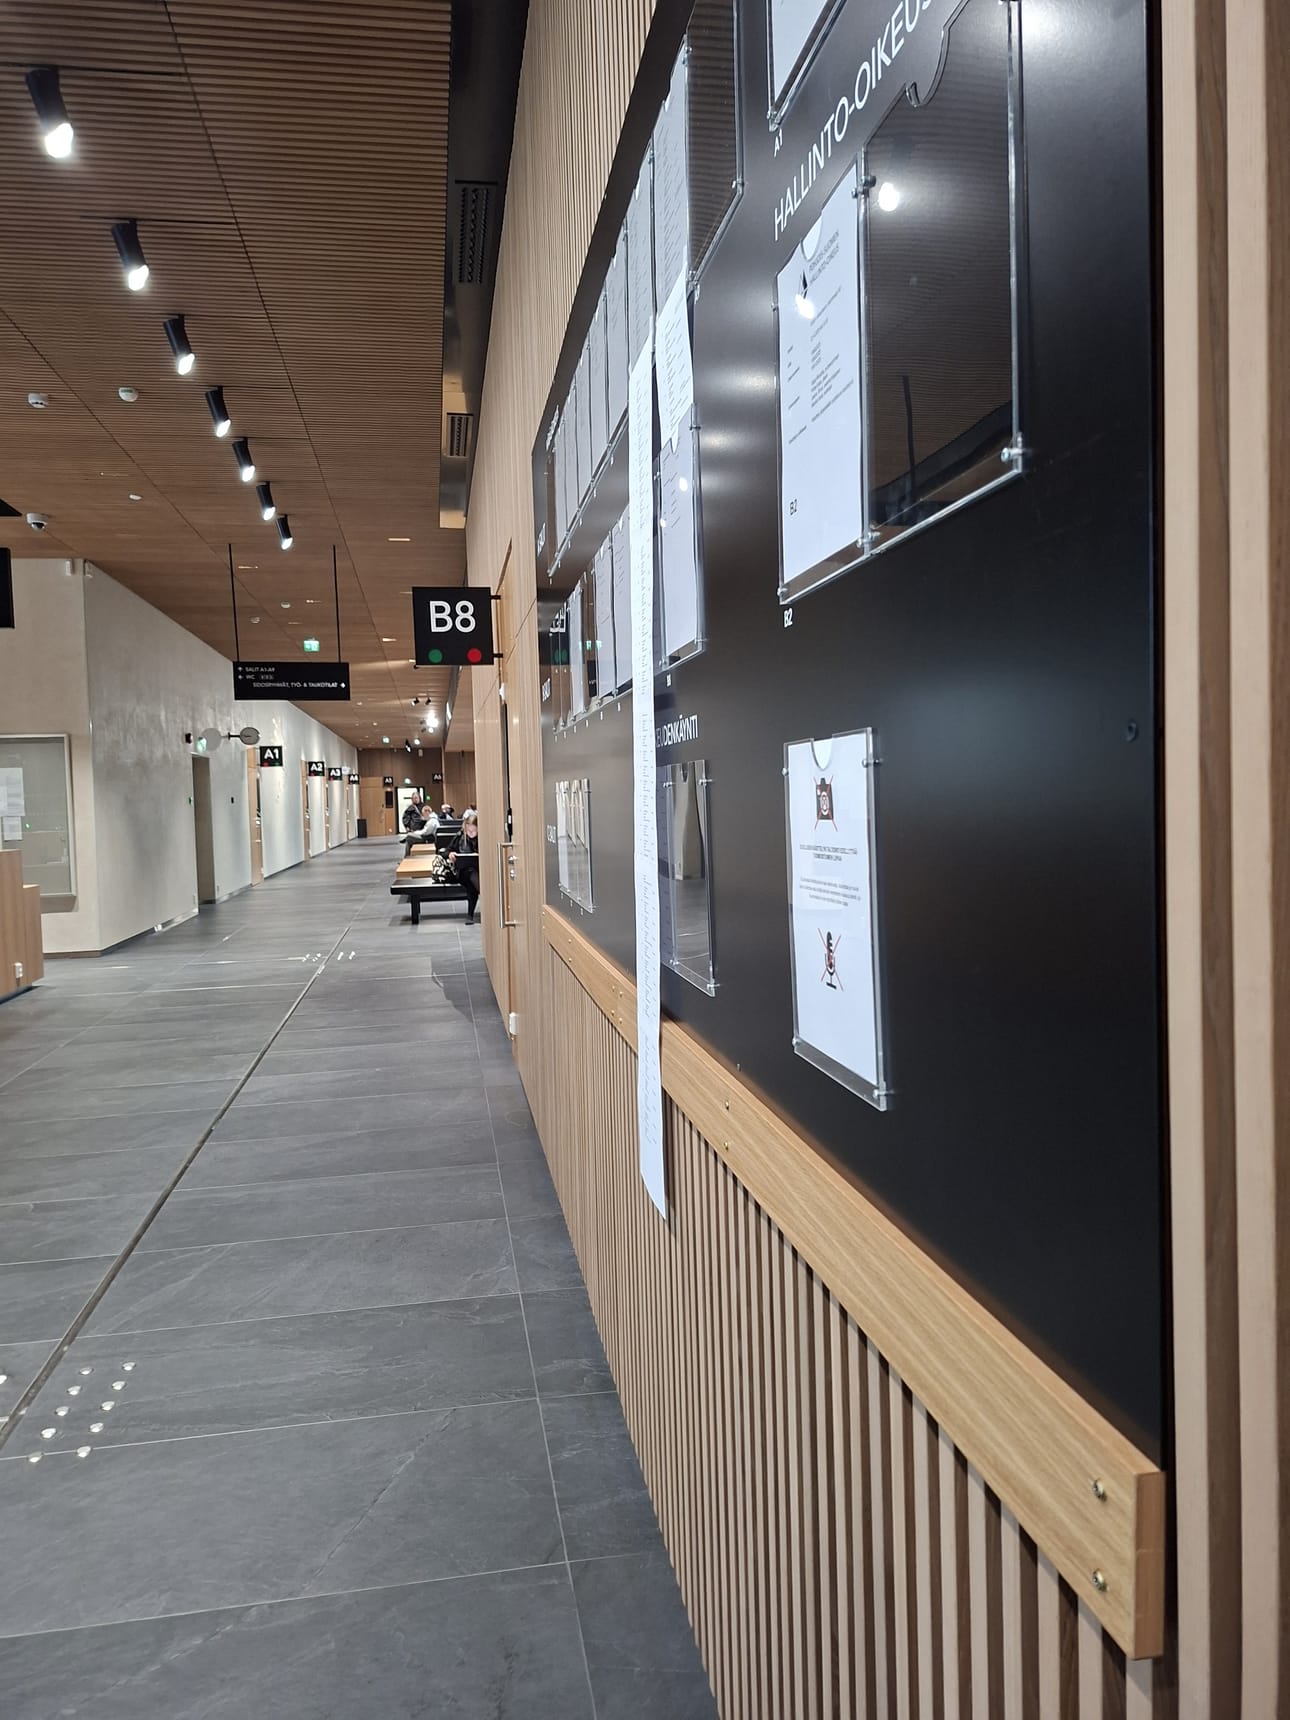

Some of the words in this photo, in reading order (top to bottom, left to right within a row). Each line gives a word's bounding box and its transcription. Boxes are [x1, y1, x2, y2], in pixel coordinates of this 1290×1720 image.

[774, 128, 783, 158] A1
[429, 600, 476, 633] B8
[783, 607, 793, 628] B2
[655, 713, 699, 749] EUDENKÄYNTI
[264, 750, 279, 760] A1
[310, 763, 323, 772] A2
[330, 769, 341, 777] A3
